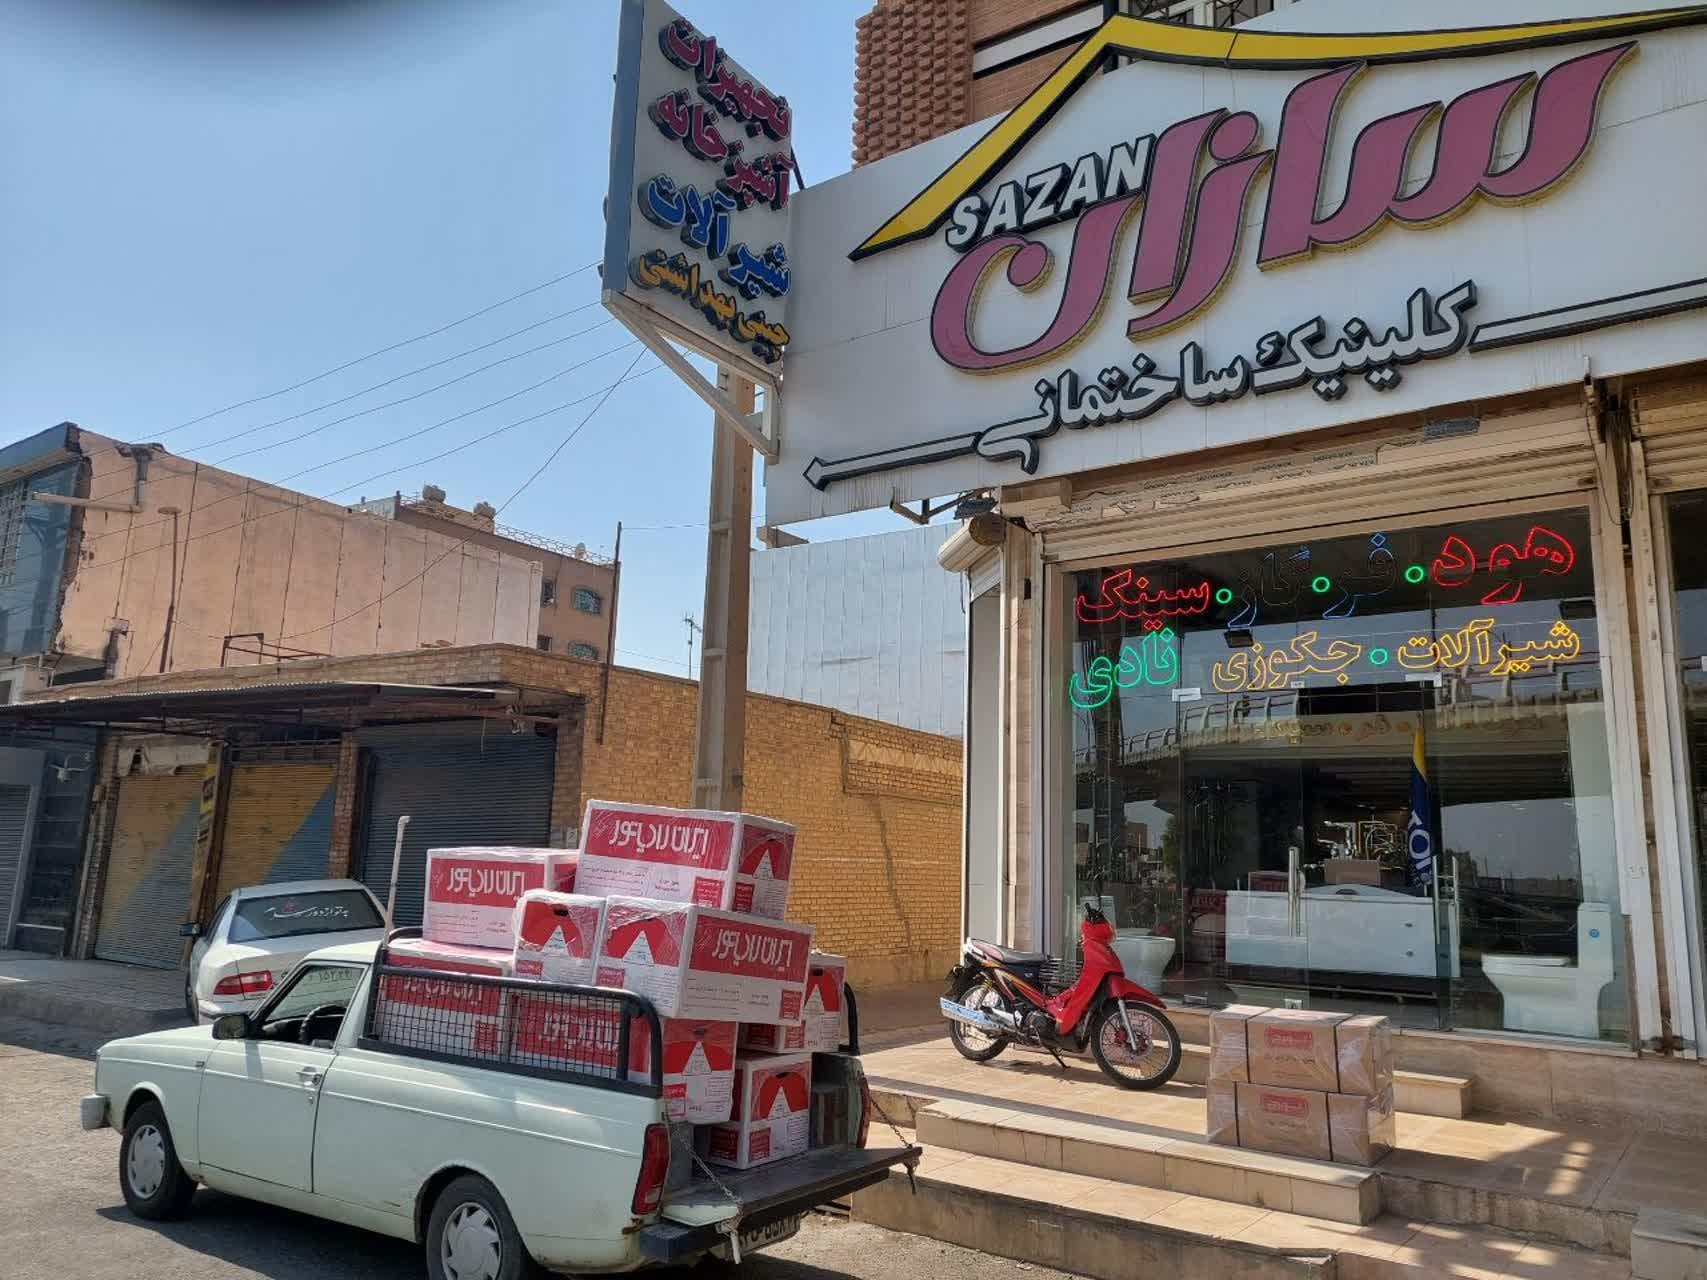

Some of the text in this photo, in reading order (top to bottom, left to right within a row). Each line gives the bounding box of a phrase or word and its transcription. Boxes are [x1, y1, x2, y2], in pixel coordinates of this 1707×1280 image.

[930, 40, 1640, 376] سازان
[945, 133, 1158, 252] SAZAN
[627, 249, 738, 331] بهداشتی
[975, 340, 1250, 475] ساختمانی
[1075, 568, 1211, 630] سینک
[608, 819, 710, 860] ایران رادیاتور
[446, 867, 495, 897] رادیاتور
[711, 928, 793, 972] ایران رادیاتور
